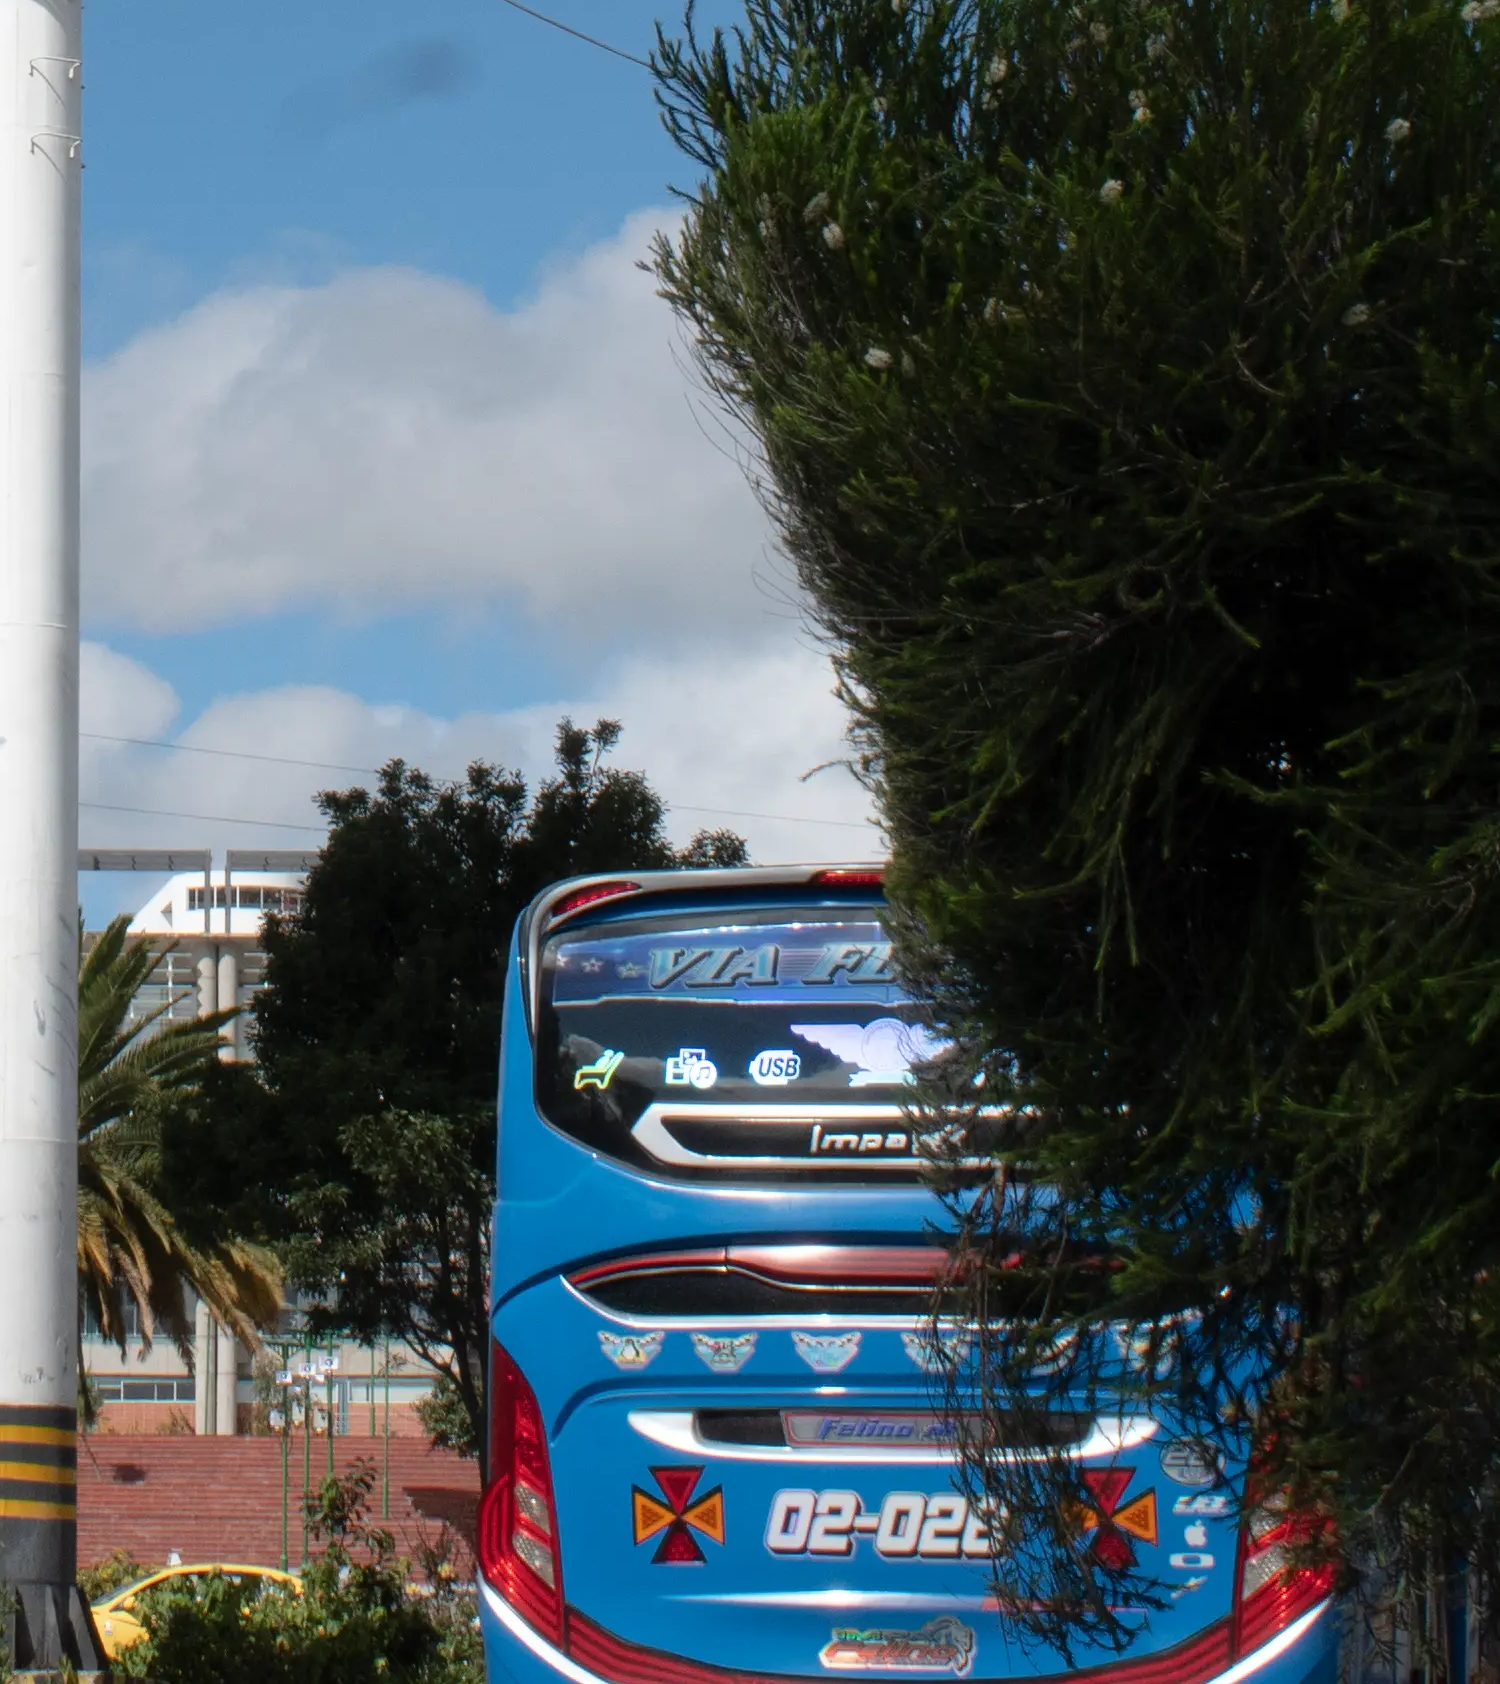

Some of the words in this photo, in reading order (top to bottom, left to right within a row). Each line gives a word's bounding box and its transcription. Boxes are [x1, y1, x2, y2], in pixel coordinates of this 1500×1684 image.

[648, 943, 781, 989] VIA
[757, 1055, 798, 1077] USB
[818, 1416, 915, 1440] Felino
